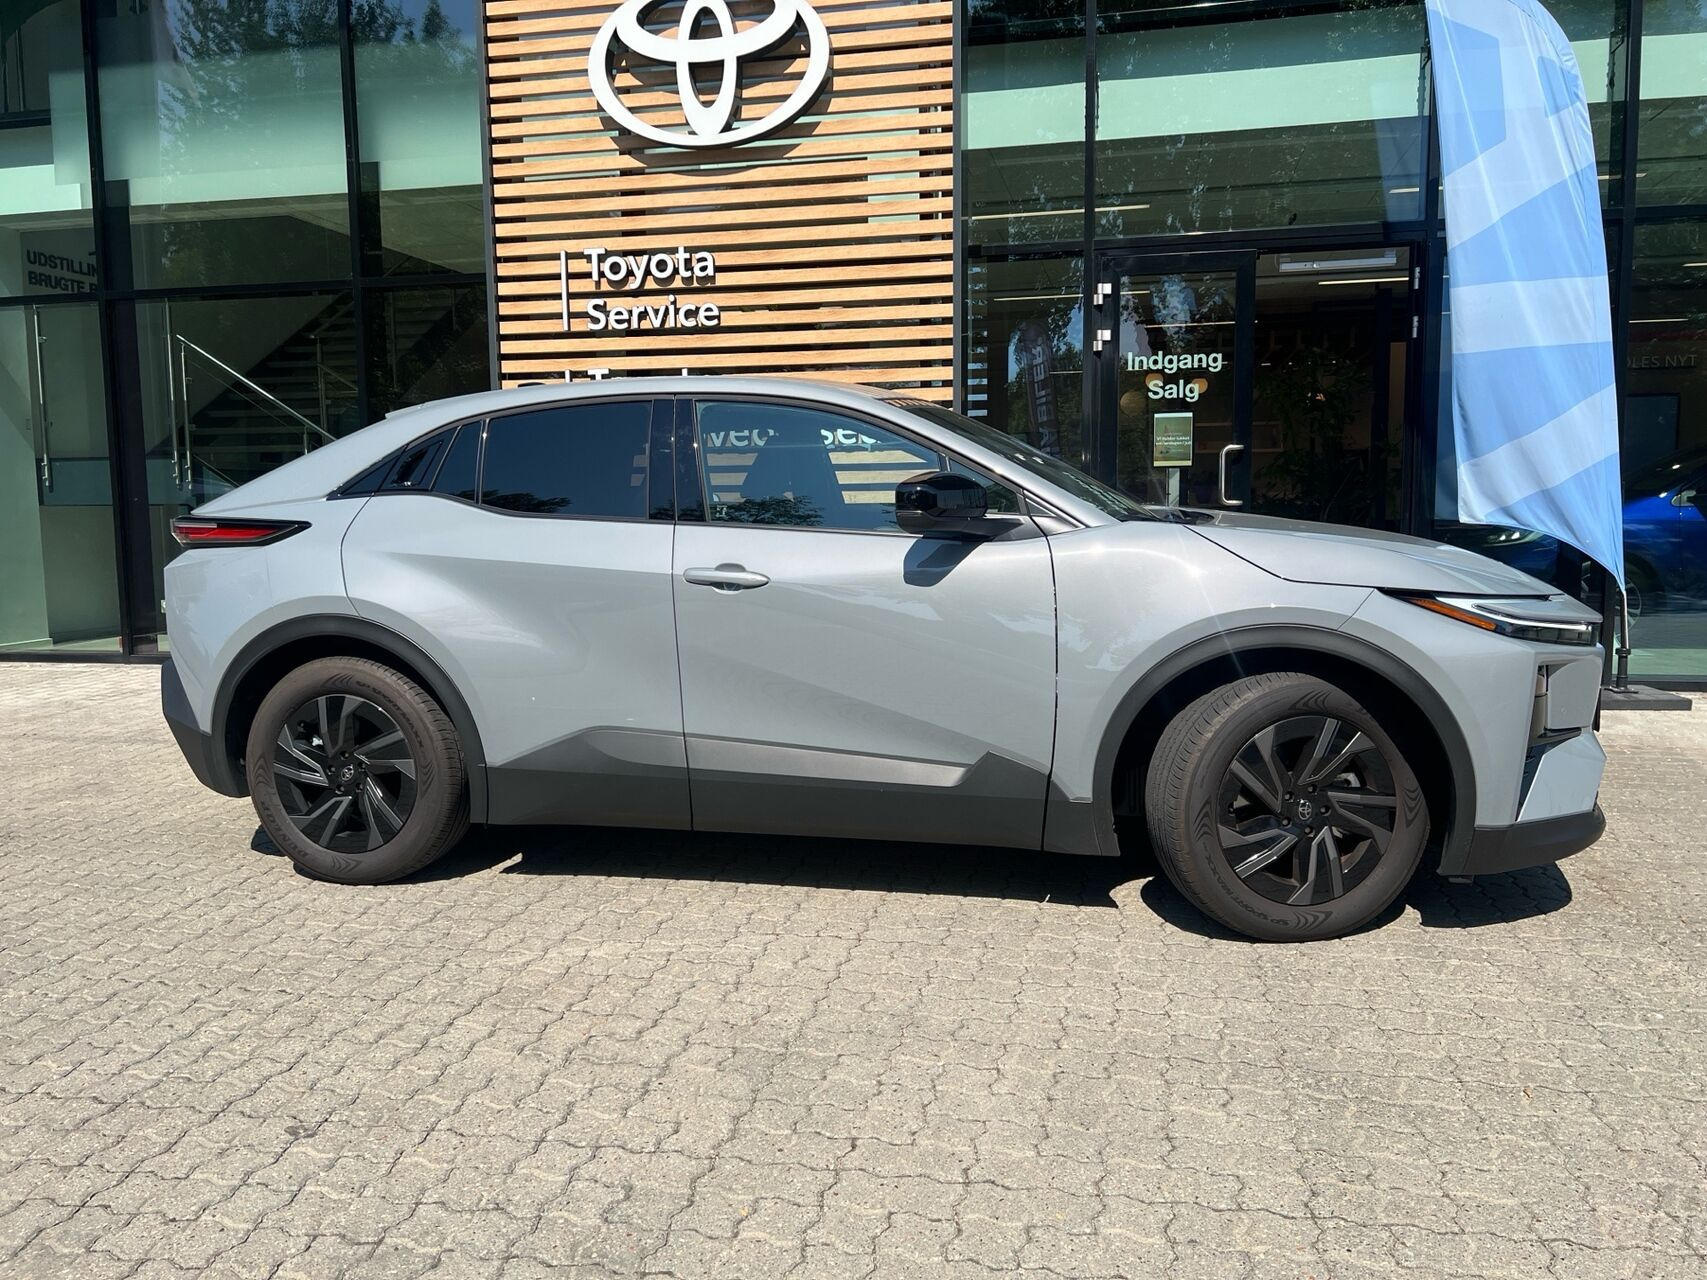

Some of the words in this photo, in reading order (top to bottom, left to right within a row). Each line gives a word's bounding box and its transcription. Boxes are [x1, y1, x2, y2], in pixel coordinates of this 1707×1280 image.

[584, 246, 715, 289] Toyota
[28, 271, 86, 293] BRUGTE
[587, 294, 720, 330] Service
[1127, 351, 1223, 374] Indgang
[1665, 354, 1697, 367] NYT
[1148, 379, 1200, 402] Salg
